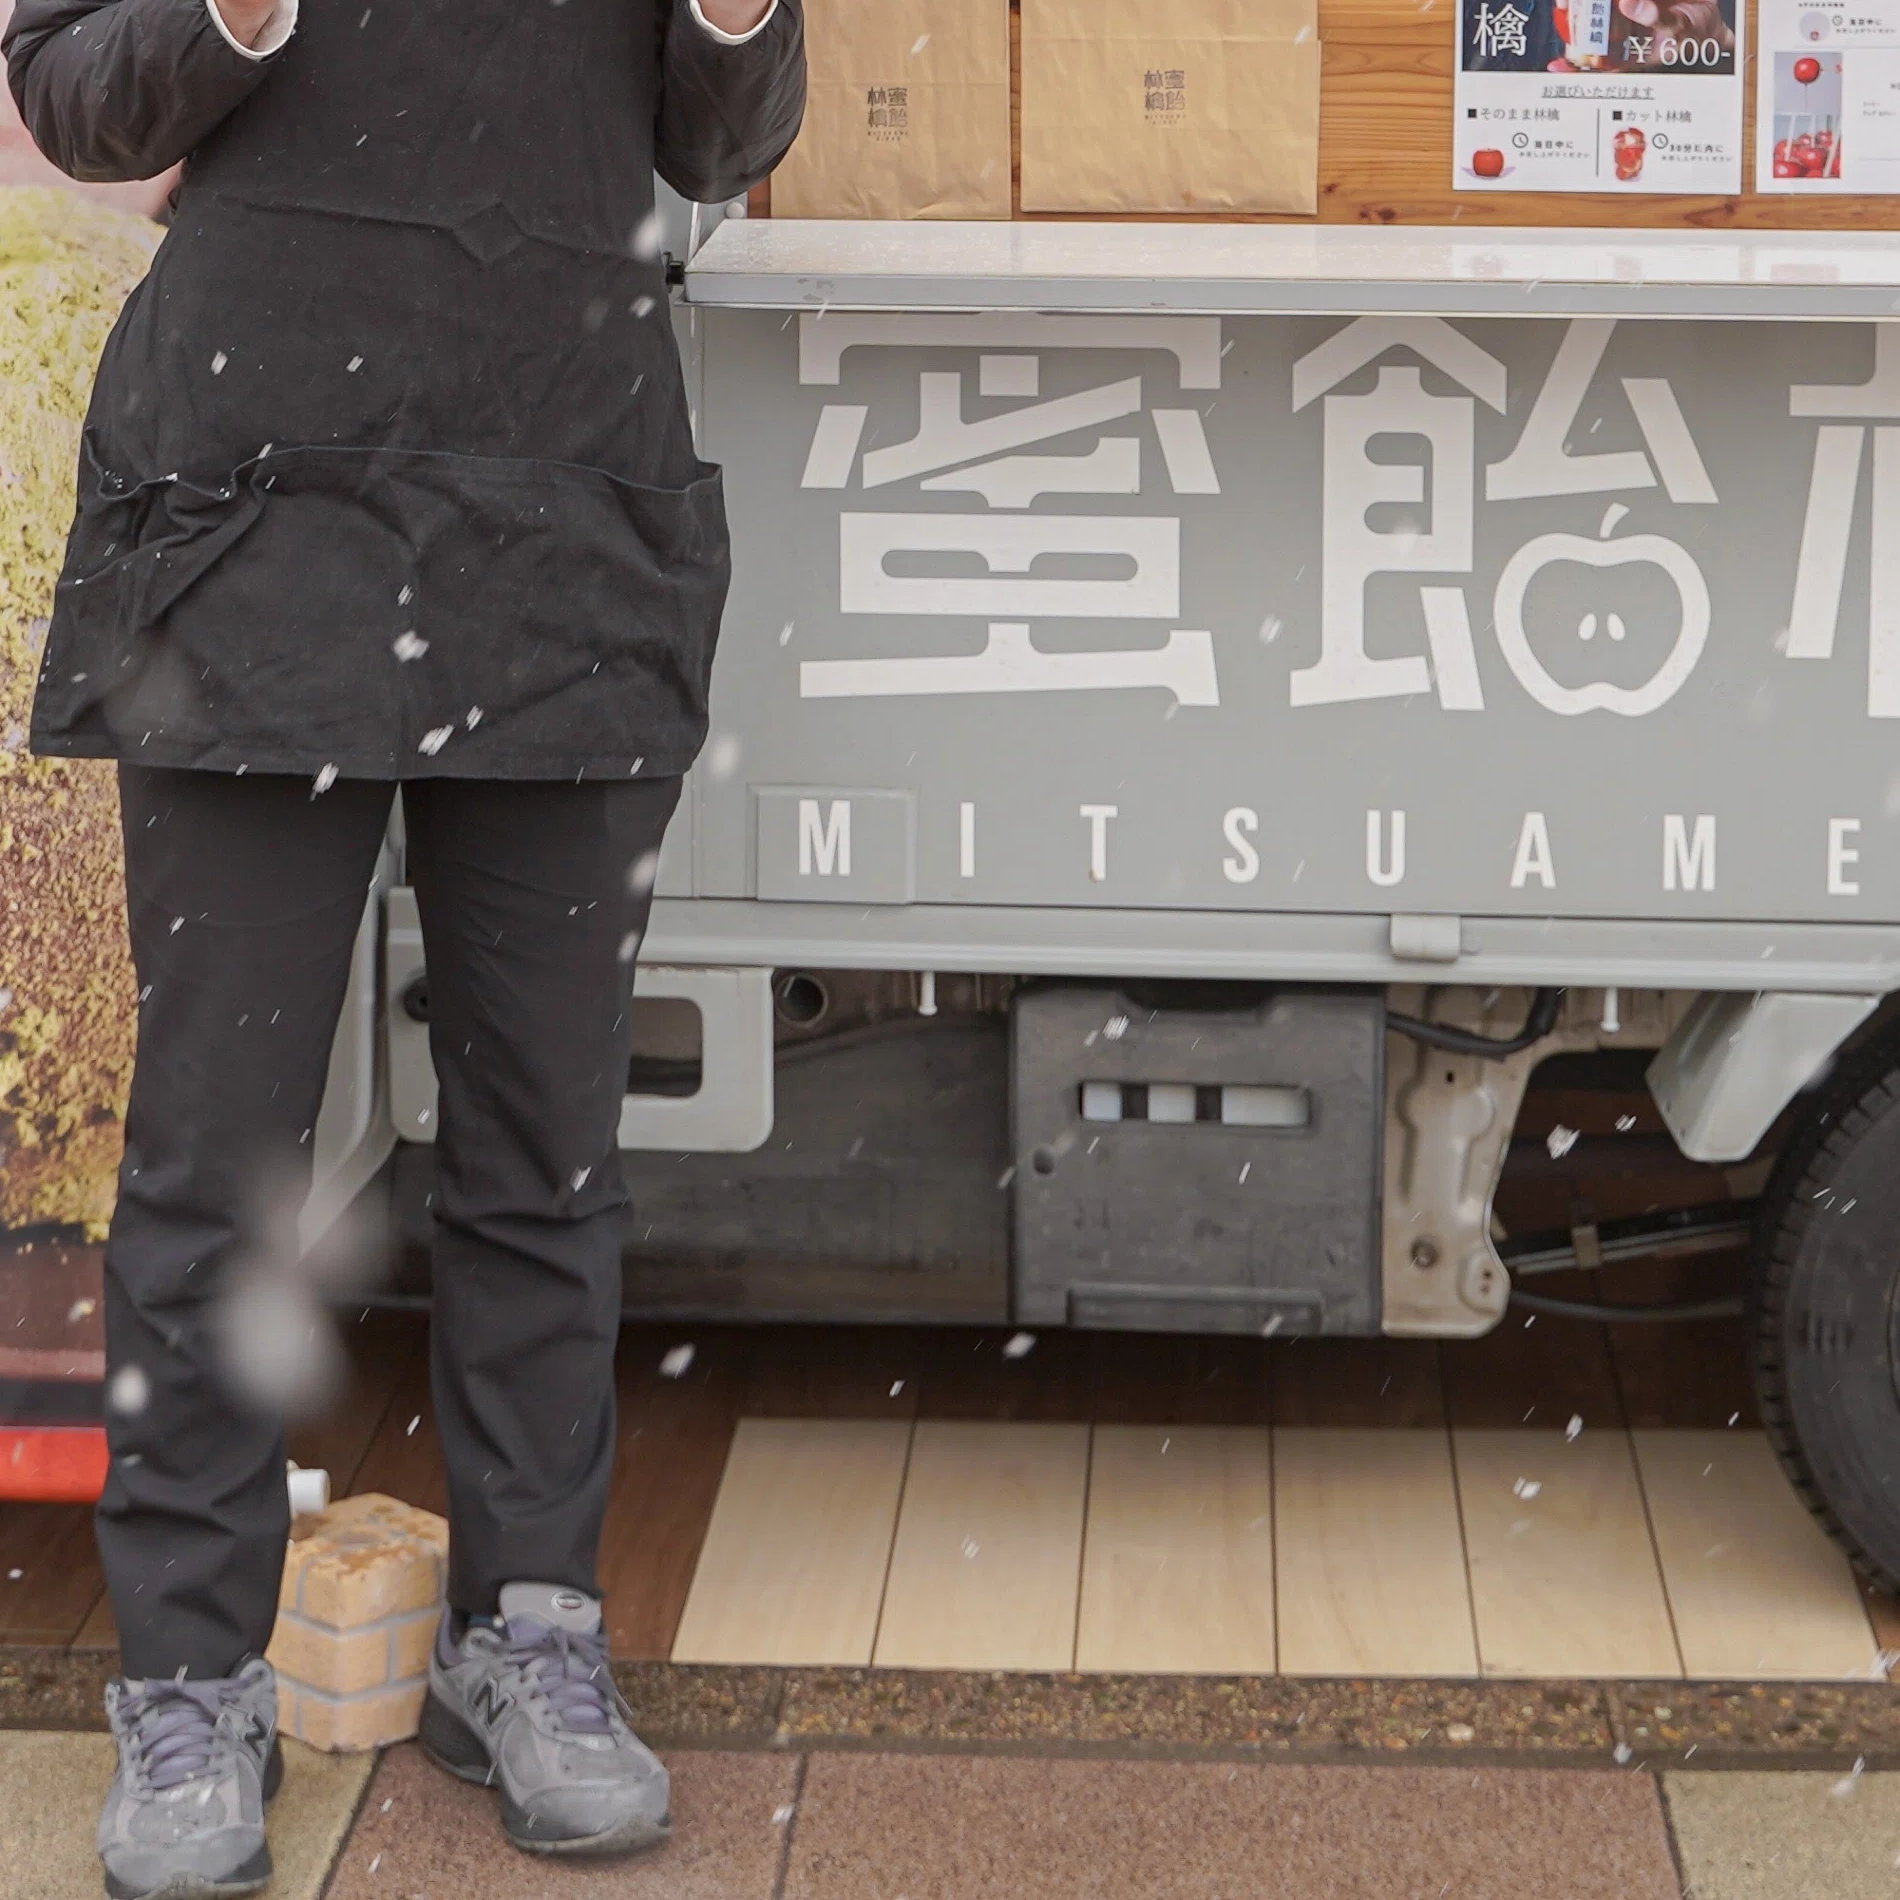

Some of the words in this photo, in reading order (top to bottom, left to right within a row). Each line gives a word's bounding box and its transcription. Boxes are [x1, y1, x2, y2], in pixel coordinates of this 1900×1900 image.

[1542, 86, 1655, 99] お選びいただけます
[797, 800, 1861, 895] MITSUAME
